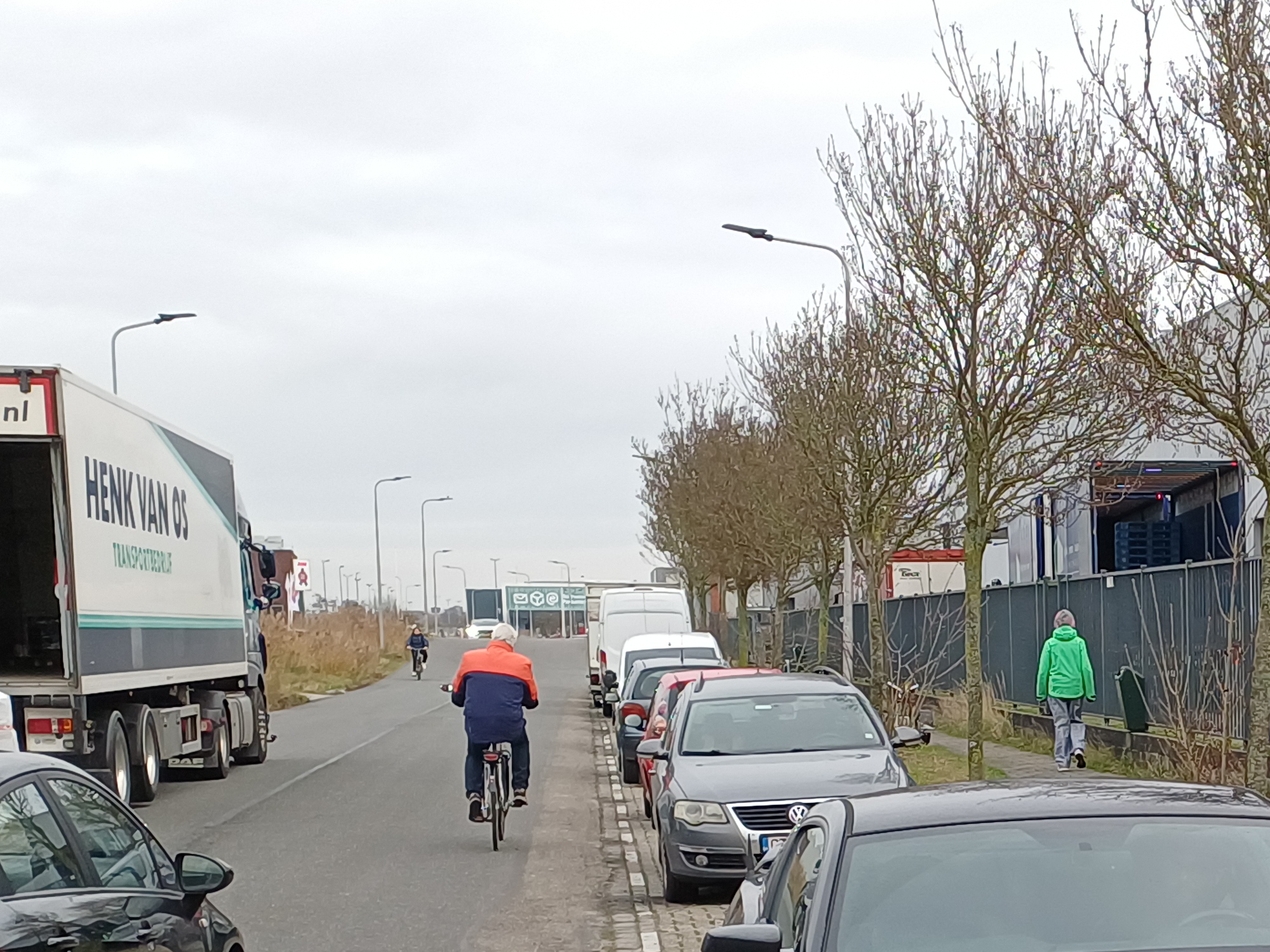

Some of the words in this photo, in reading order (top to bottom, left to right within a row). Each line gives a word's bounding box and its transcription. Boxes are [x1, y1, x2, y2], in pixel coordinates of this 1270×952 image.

[84, 455, 136, 530] HENK
[136, 473, 170, 537] VAN
[172, 486, 189, 541] OS
[112, 542, 172, 574] TRANSPORTBEDRIJF
[168, 757, 205, 766] DAF
